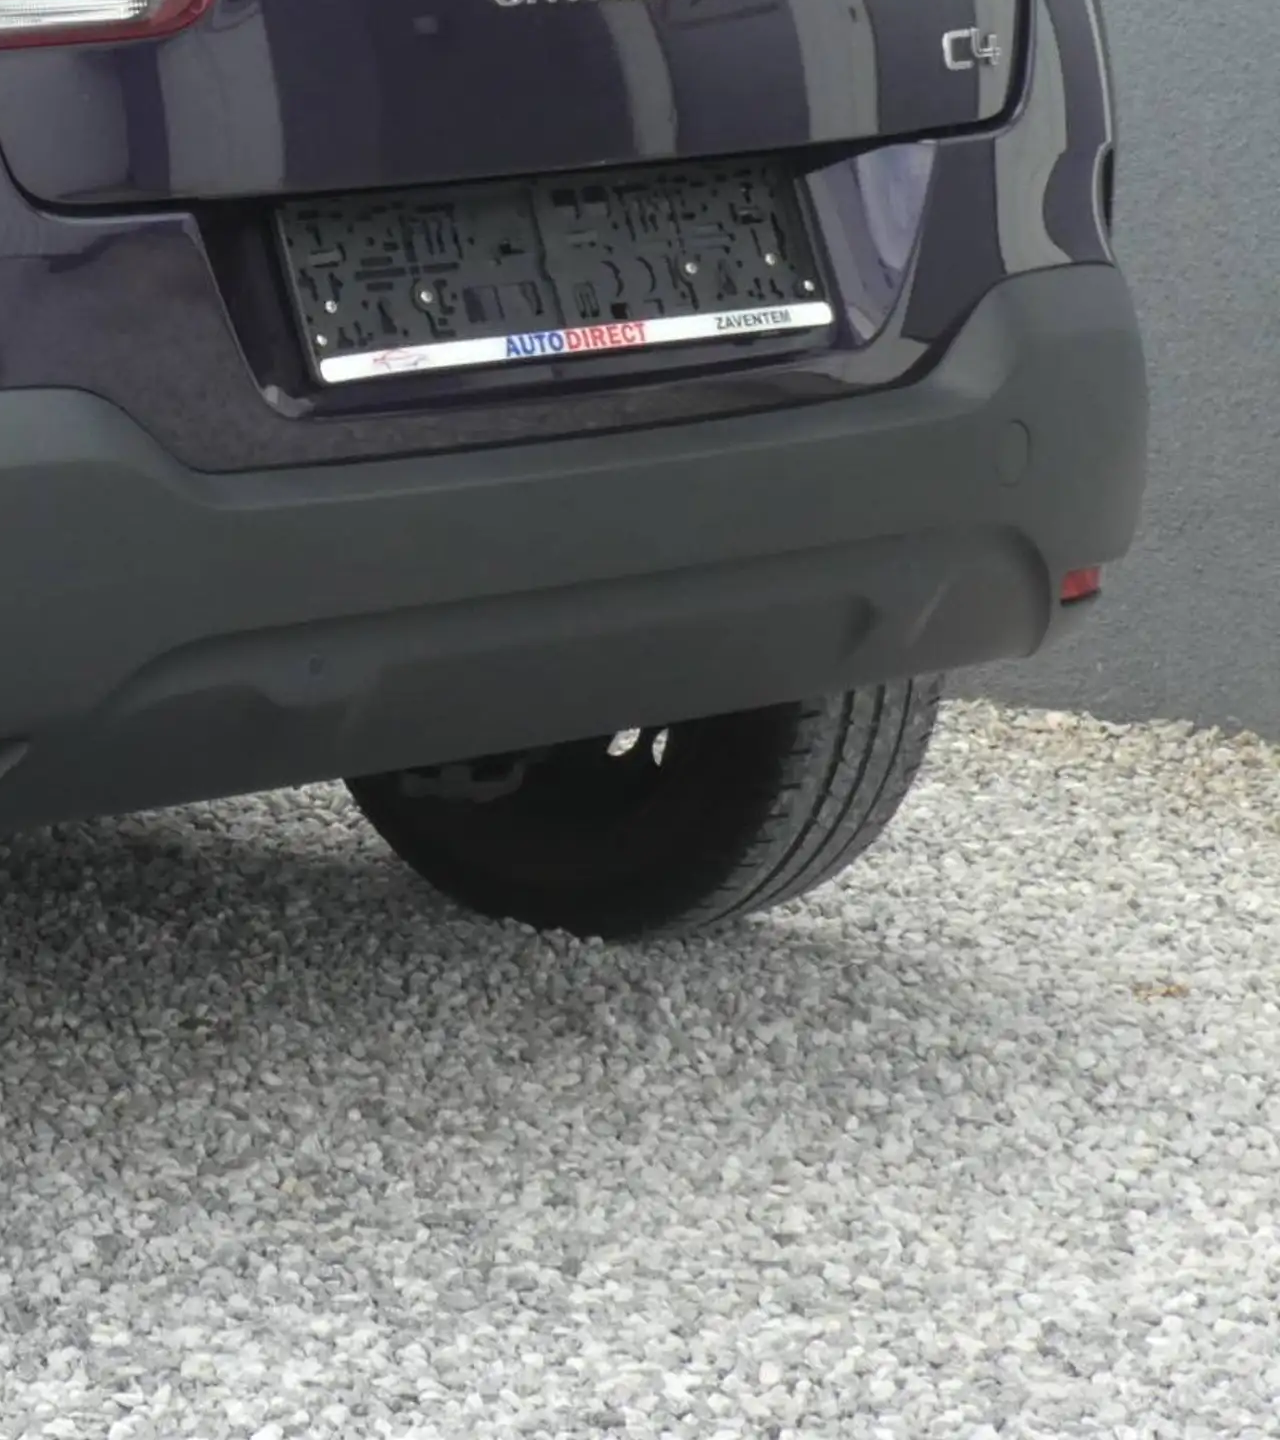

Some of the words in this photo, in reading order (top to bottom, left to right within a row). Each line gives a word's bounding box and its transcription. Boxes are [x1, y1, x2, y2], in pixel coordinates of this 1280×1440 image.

[941, 26, 1001, 71] C4
[714, 308, 792, 330] ZAVENTEM
[506, 322, 646, 357] AUTODIRECT
